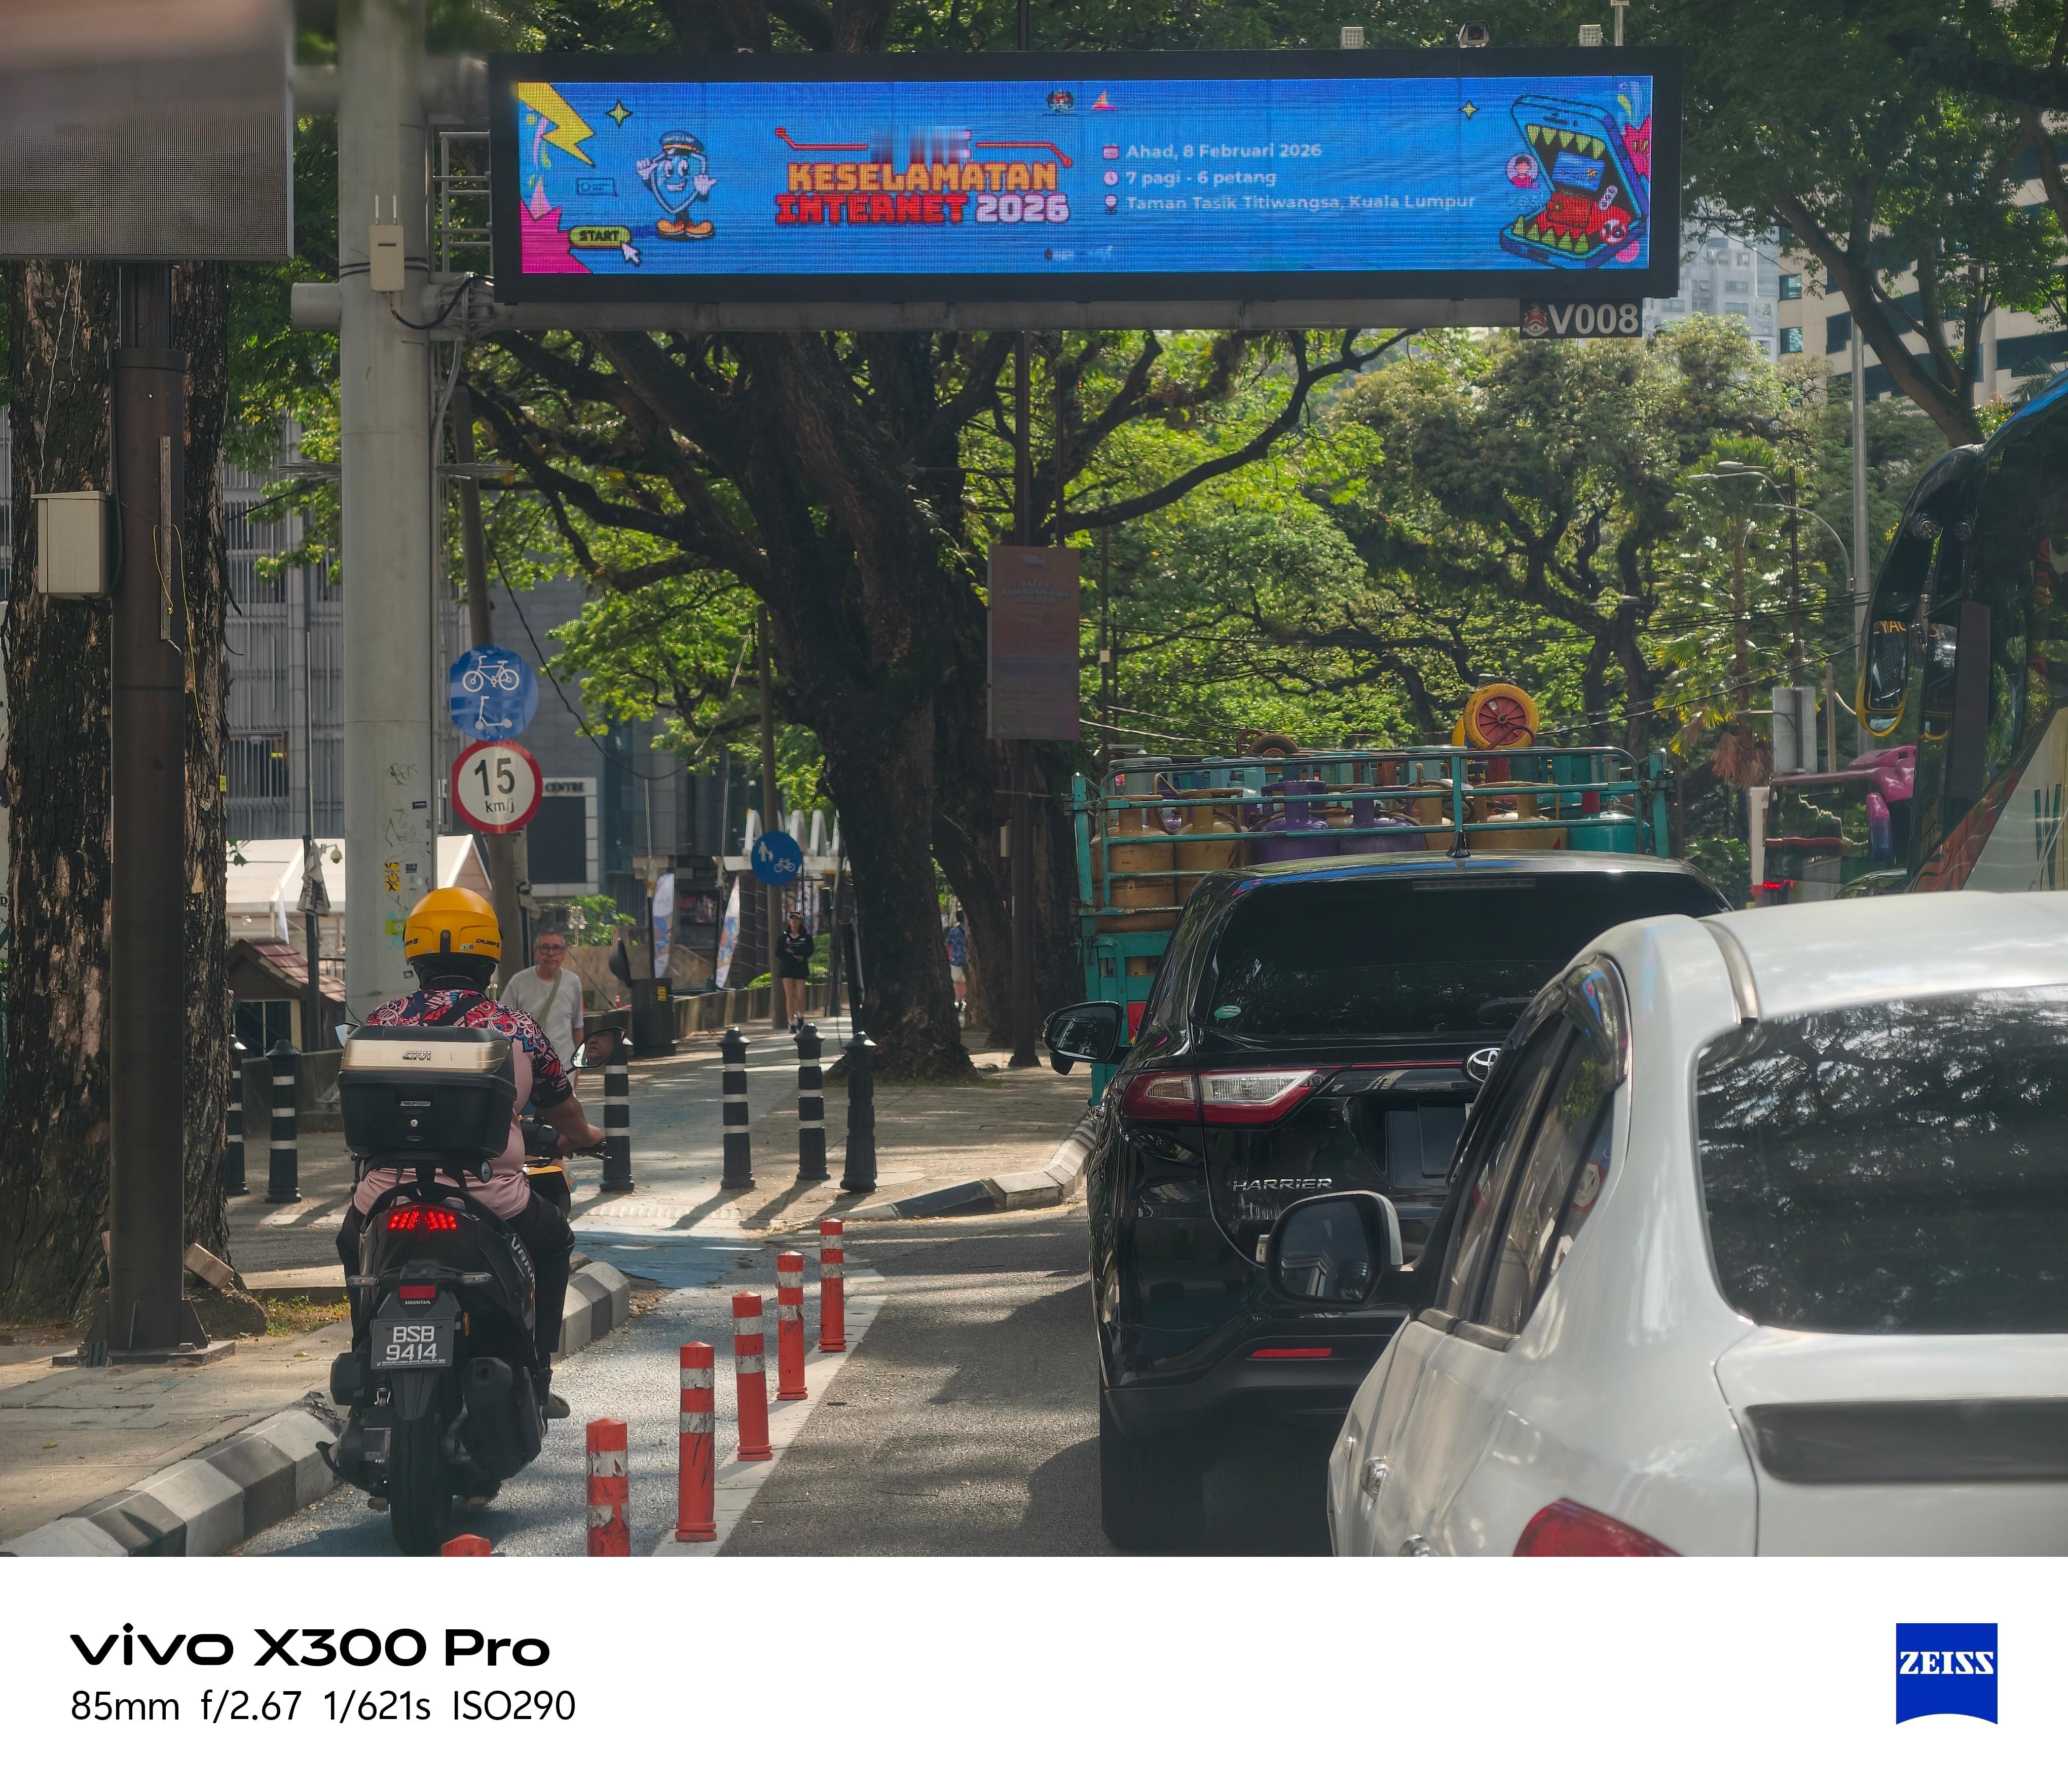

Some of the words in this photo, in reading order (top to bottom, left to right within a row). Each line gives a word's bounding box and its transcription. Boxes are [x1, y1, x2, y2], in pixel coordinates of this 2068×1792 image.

[1126, 144, 1178, 160] Ahad,
[1184, 145, 1194, 157] 8
[1199, 143, 1274, 158] Februari
[1279, 144, 1322, 158] 2026
[788, 162, 1058, 191] KESELAMATAN
[1126, 171, 1137, 184] 7
[1142, 170, 1180, 188] pagi
[1198, 171, 1208, 184] 6
[1213, 170, 1277, 187] petang
[776, 194, 969, 223] INTERNET
[975, 193, 1070, 223] 2026
[1127, 197, 1187, 210] Taman
[1193, 196, 1237, 209] Tasik
[1243, 195, 1344, 212] Titiwangsa,
[1349, 195, 1399, 208] Kuala
[1404, 195, 1475, 211] Lumpur
[579, 230, 618, 241] START
[1548, 303, 1639, 335] V008
[474, 758, 515, 796] 15
[485, 798, 514, 813] km/j
[402, 1050, 431, 1060] GIVI
[1233, 1177, 1333, 1191] HARRIER
[393, 1326, 434, 1343] BSB
[386, 1343, 437, 1361] 9414
